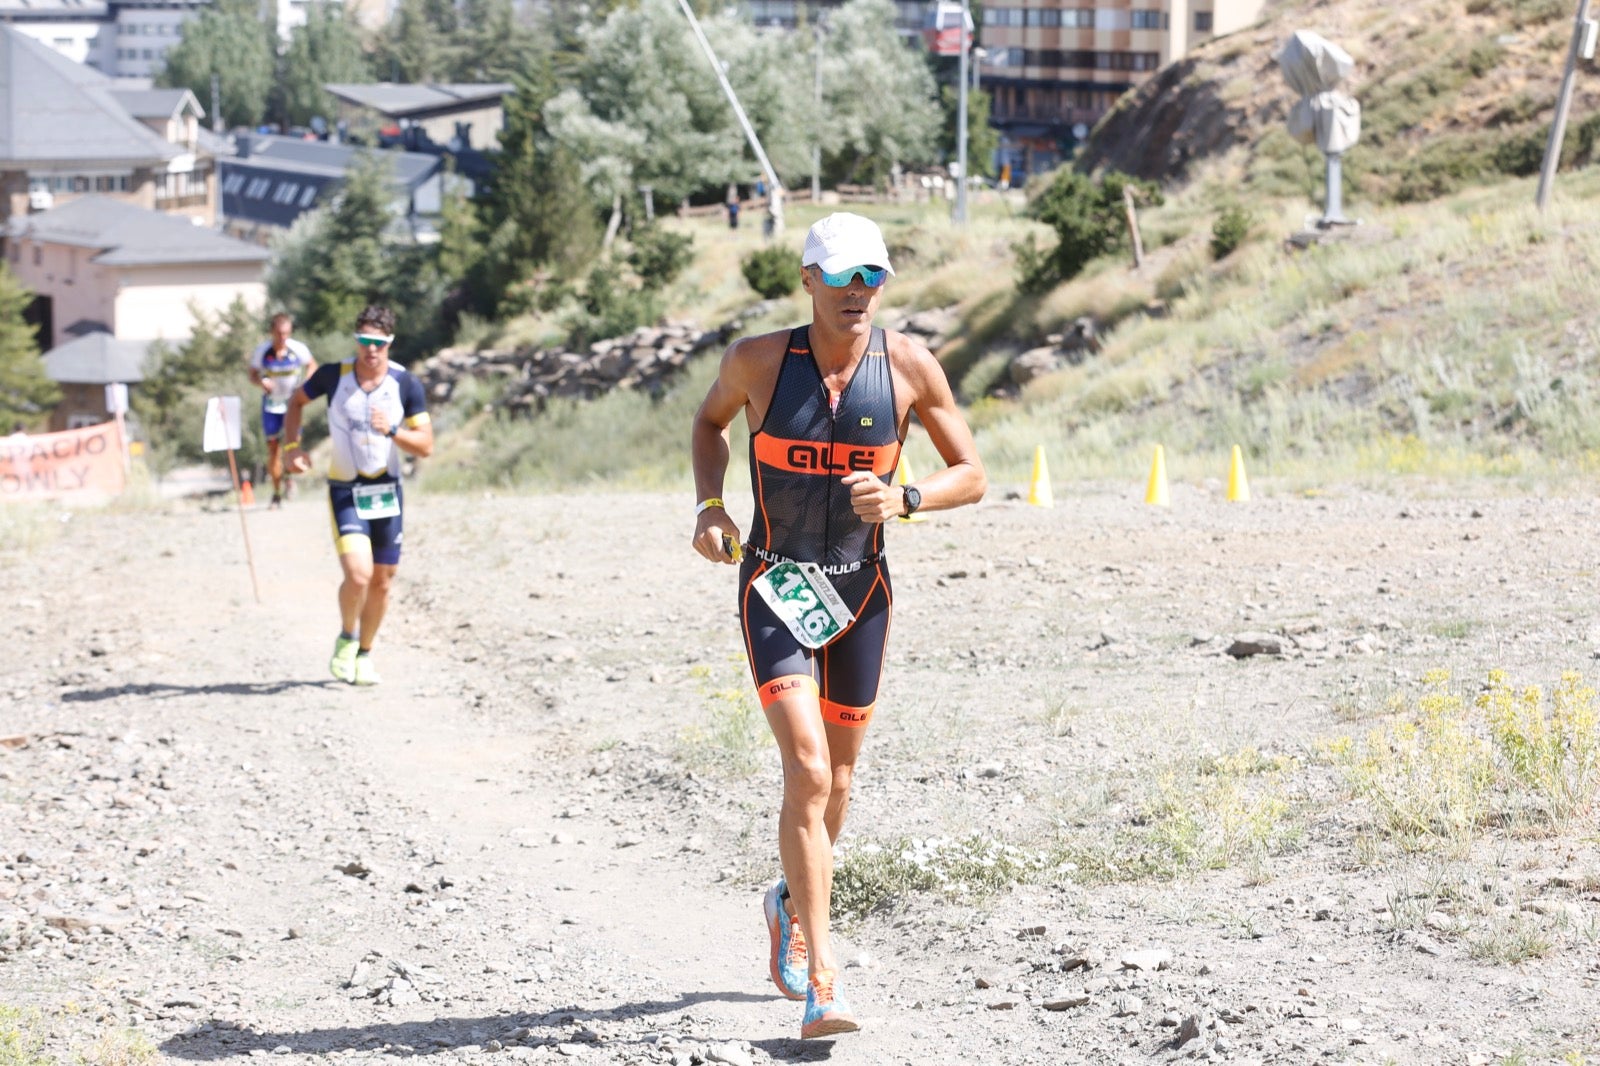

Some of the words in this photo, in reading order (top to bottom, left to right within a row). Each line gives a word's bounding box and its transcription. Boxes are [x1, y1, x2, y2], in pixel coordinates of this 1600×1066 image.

[0, 434, 106, 463] PACIO
[0, 465, 90, 493] ONLY
[822, 562, 861, 575] HUUB
[777, 571, 831, 637] 126
[811, 572, 840, 607] RIATLON
